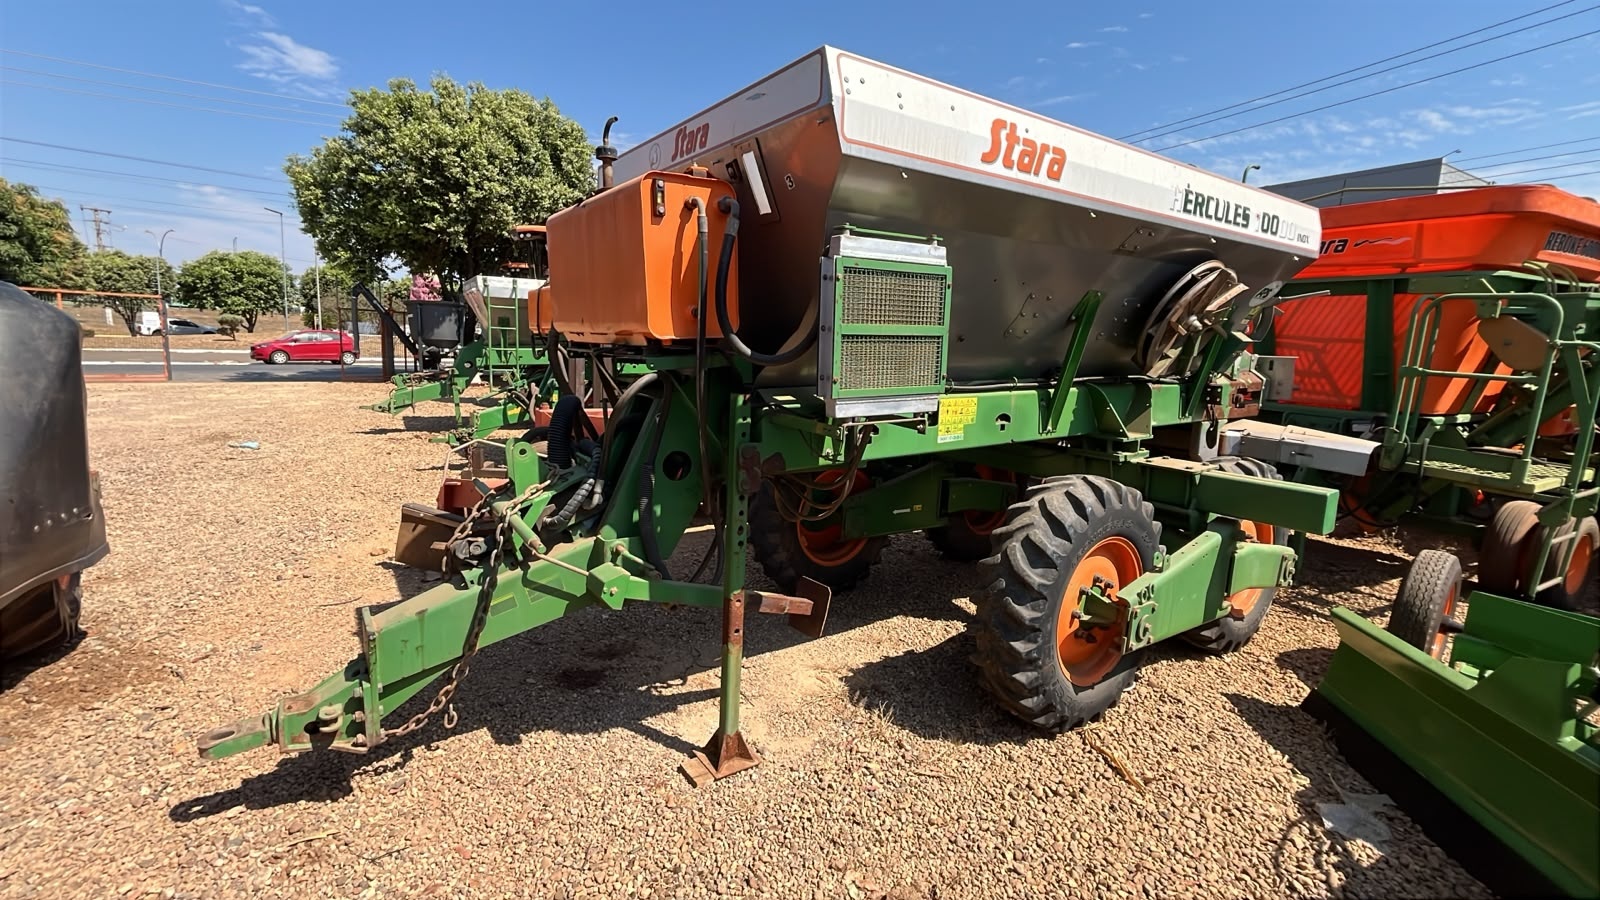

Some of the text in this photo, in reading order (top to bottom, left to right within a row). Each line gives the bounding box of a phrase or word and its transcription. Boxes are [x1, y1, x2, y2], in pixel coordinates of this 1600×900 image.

[671, 122, 710, 163] Stara
[981, 118, 1067, 182] Stara
[785, 175, 794, 188] 3
